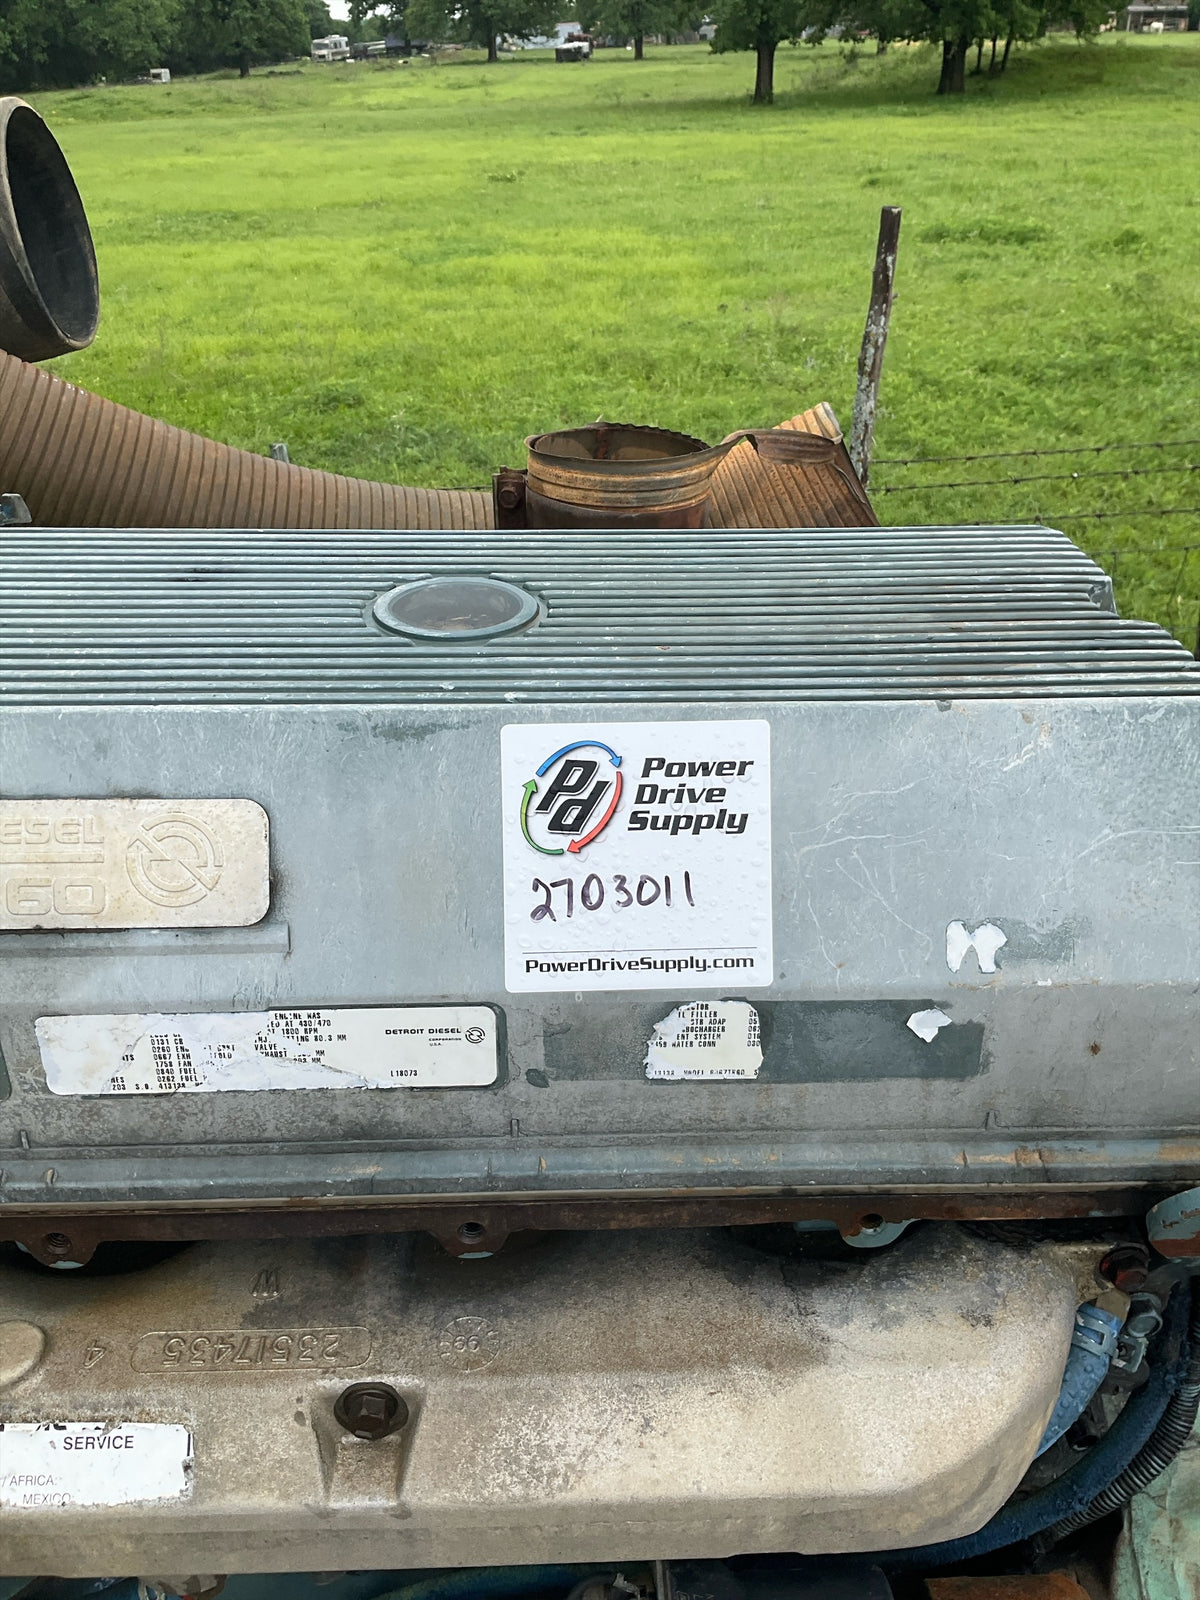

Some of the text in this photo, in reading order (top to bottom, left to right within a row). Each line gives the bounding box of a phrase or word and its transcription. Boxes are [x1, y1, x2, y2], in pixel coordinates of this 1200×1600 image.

[640, 757, 754, 778] Power
[634, 783, 726, 804] Drive
[627, 808, 749, 836] Supply
[5, 877, 106, 915] 60
[529, 870, 696, 923] 2703011
[525, 956, 755, 973] PowerDriveSupply.com
[307, 1012, 321, 1020] WAS
[691, 1010, 718, 1018] FILLER
[285, 1020, 294, 1028] AT
[708, 1018, 726, 1026] ADAP
[304, 1027, 318, 1035] RPM
[694, 1033, 721, 1041] SYSTEM
[671, 1040, 694, 1048] WATER
[698, 1040, 716, 1048] CONN
[260, 1050, 288, 1058] HAUST
[180, 1075, 199, 1083] FUEL
[63, 1436, 135, 1450] SERVICE
